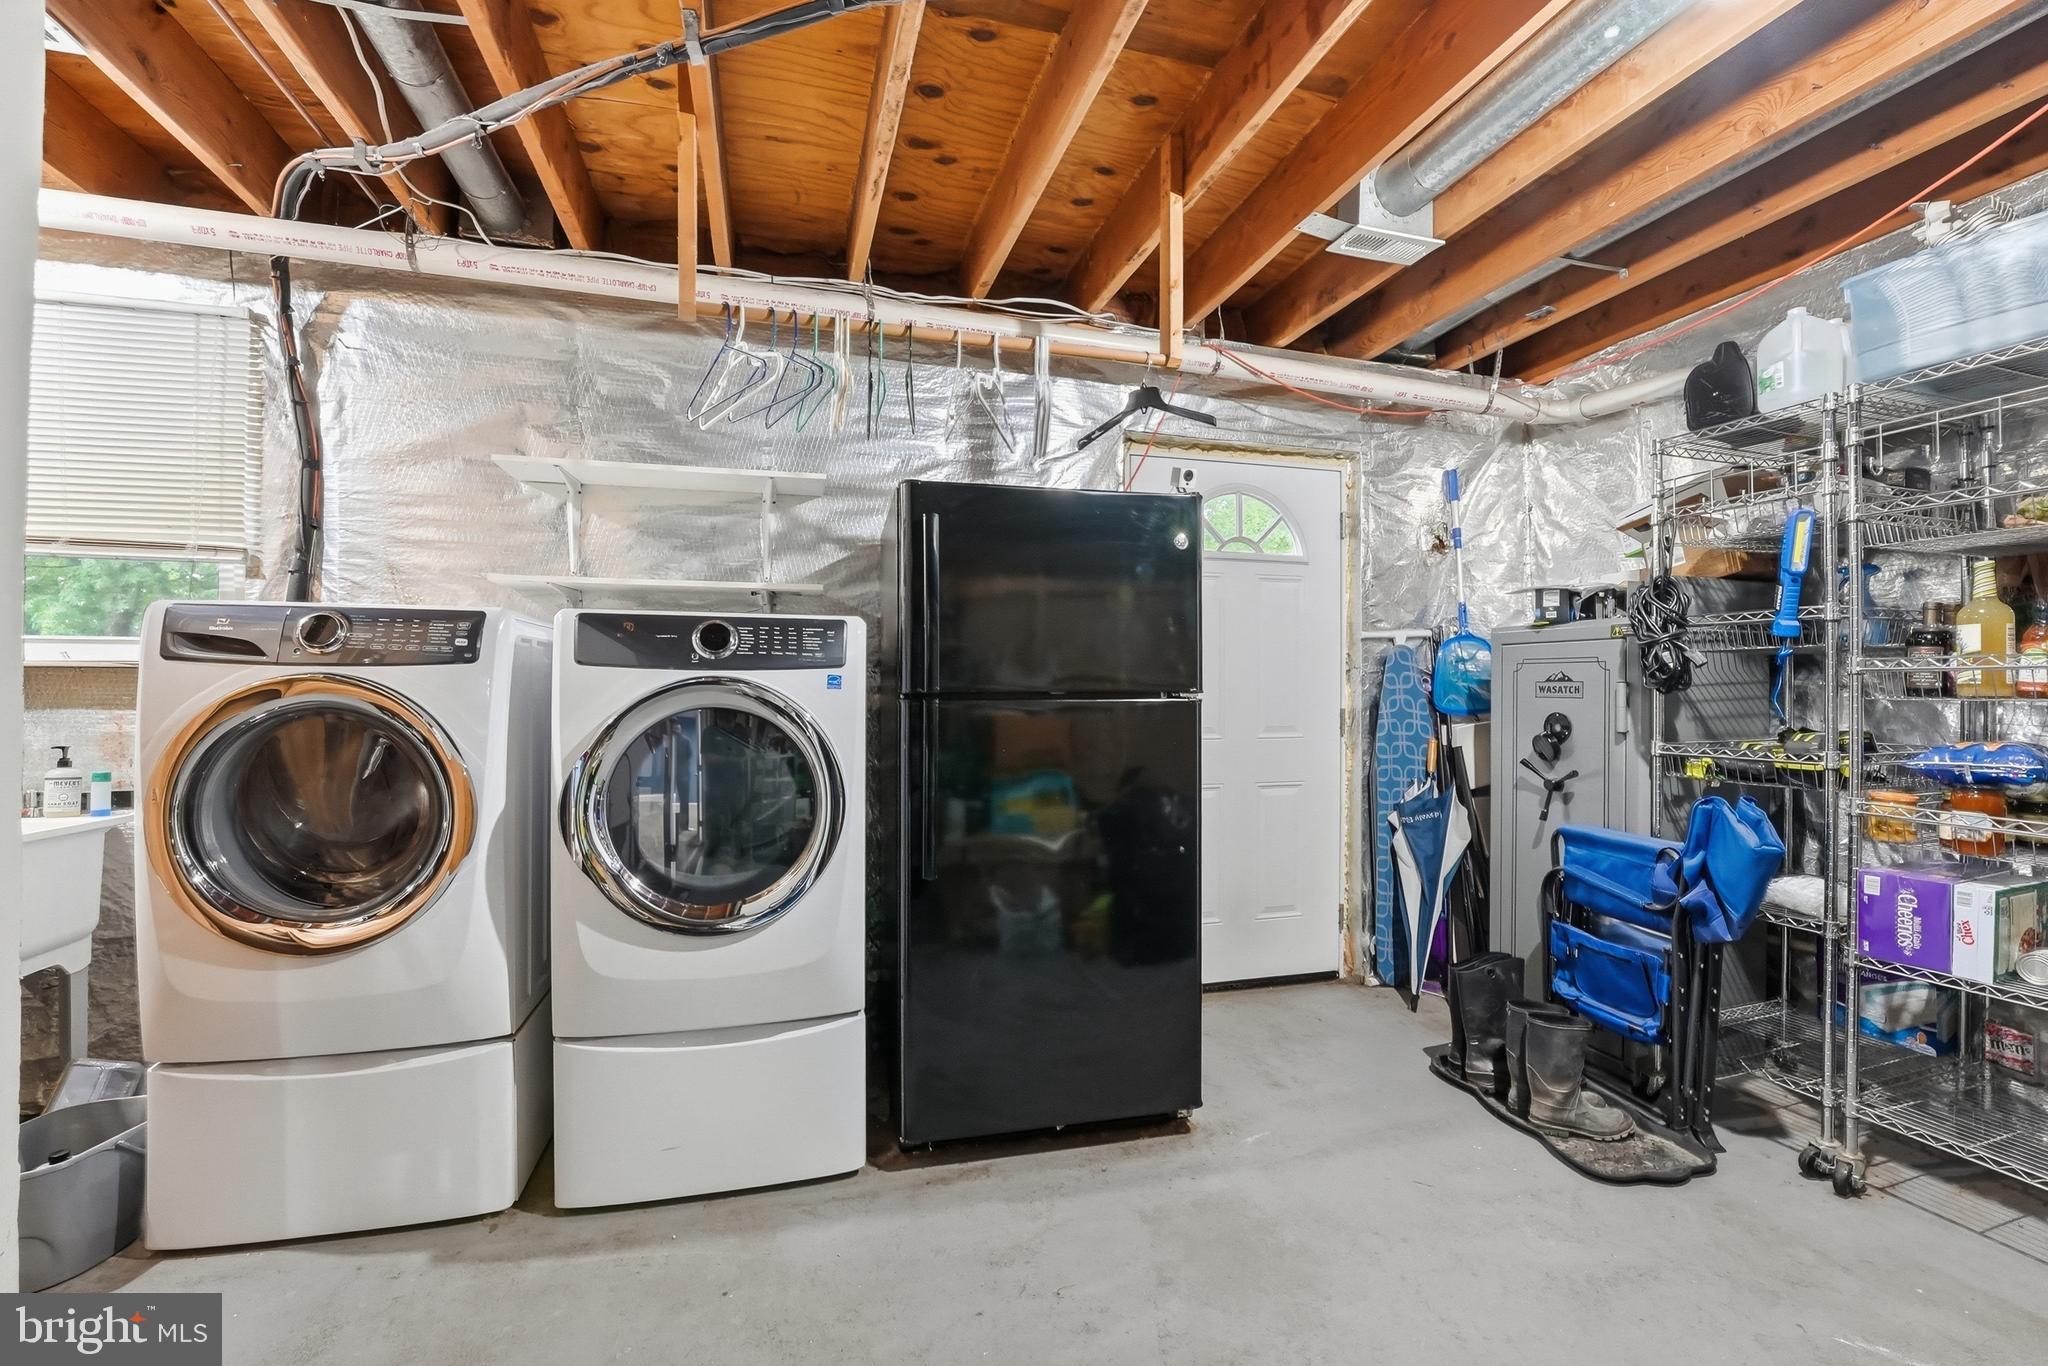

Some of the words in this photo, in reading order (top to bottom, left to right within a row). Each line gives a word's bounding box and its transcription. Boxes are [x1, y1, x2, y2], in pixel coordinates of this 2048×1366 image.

[1538, 685, 1580, 695] WASATCH
[1897, 894, 1918, 948] Cheerios
[1960, 920, 1974, 945] Chex
